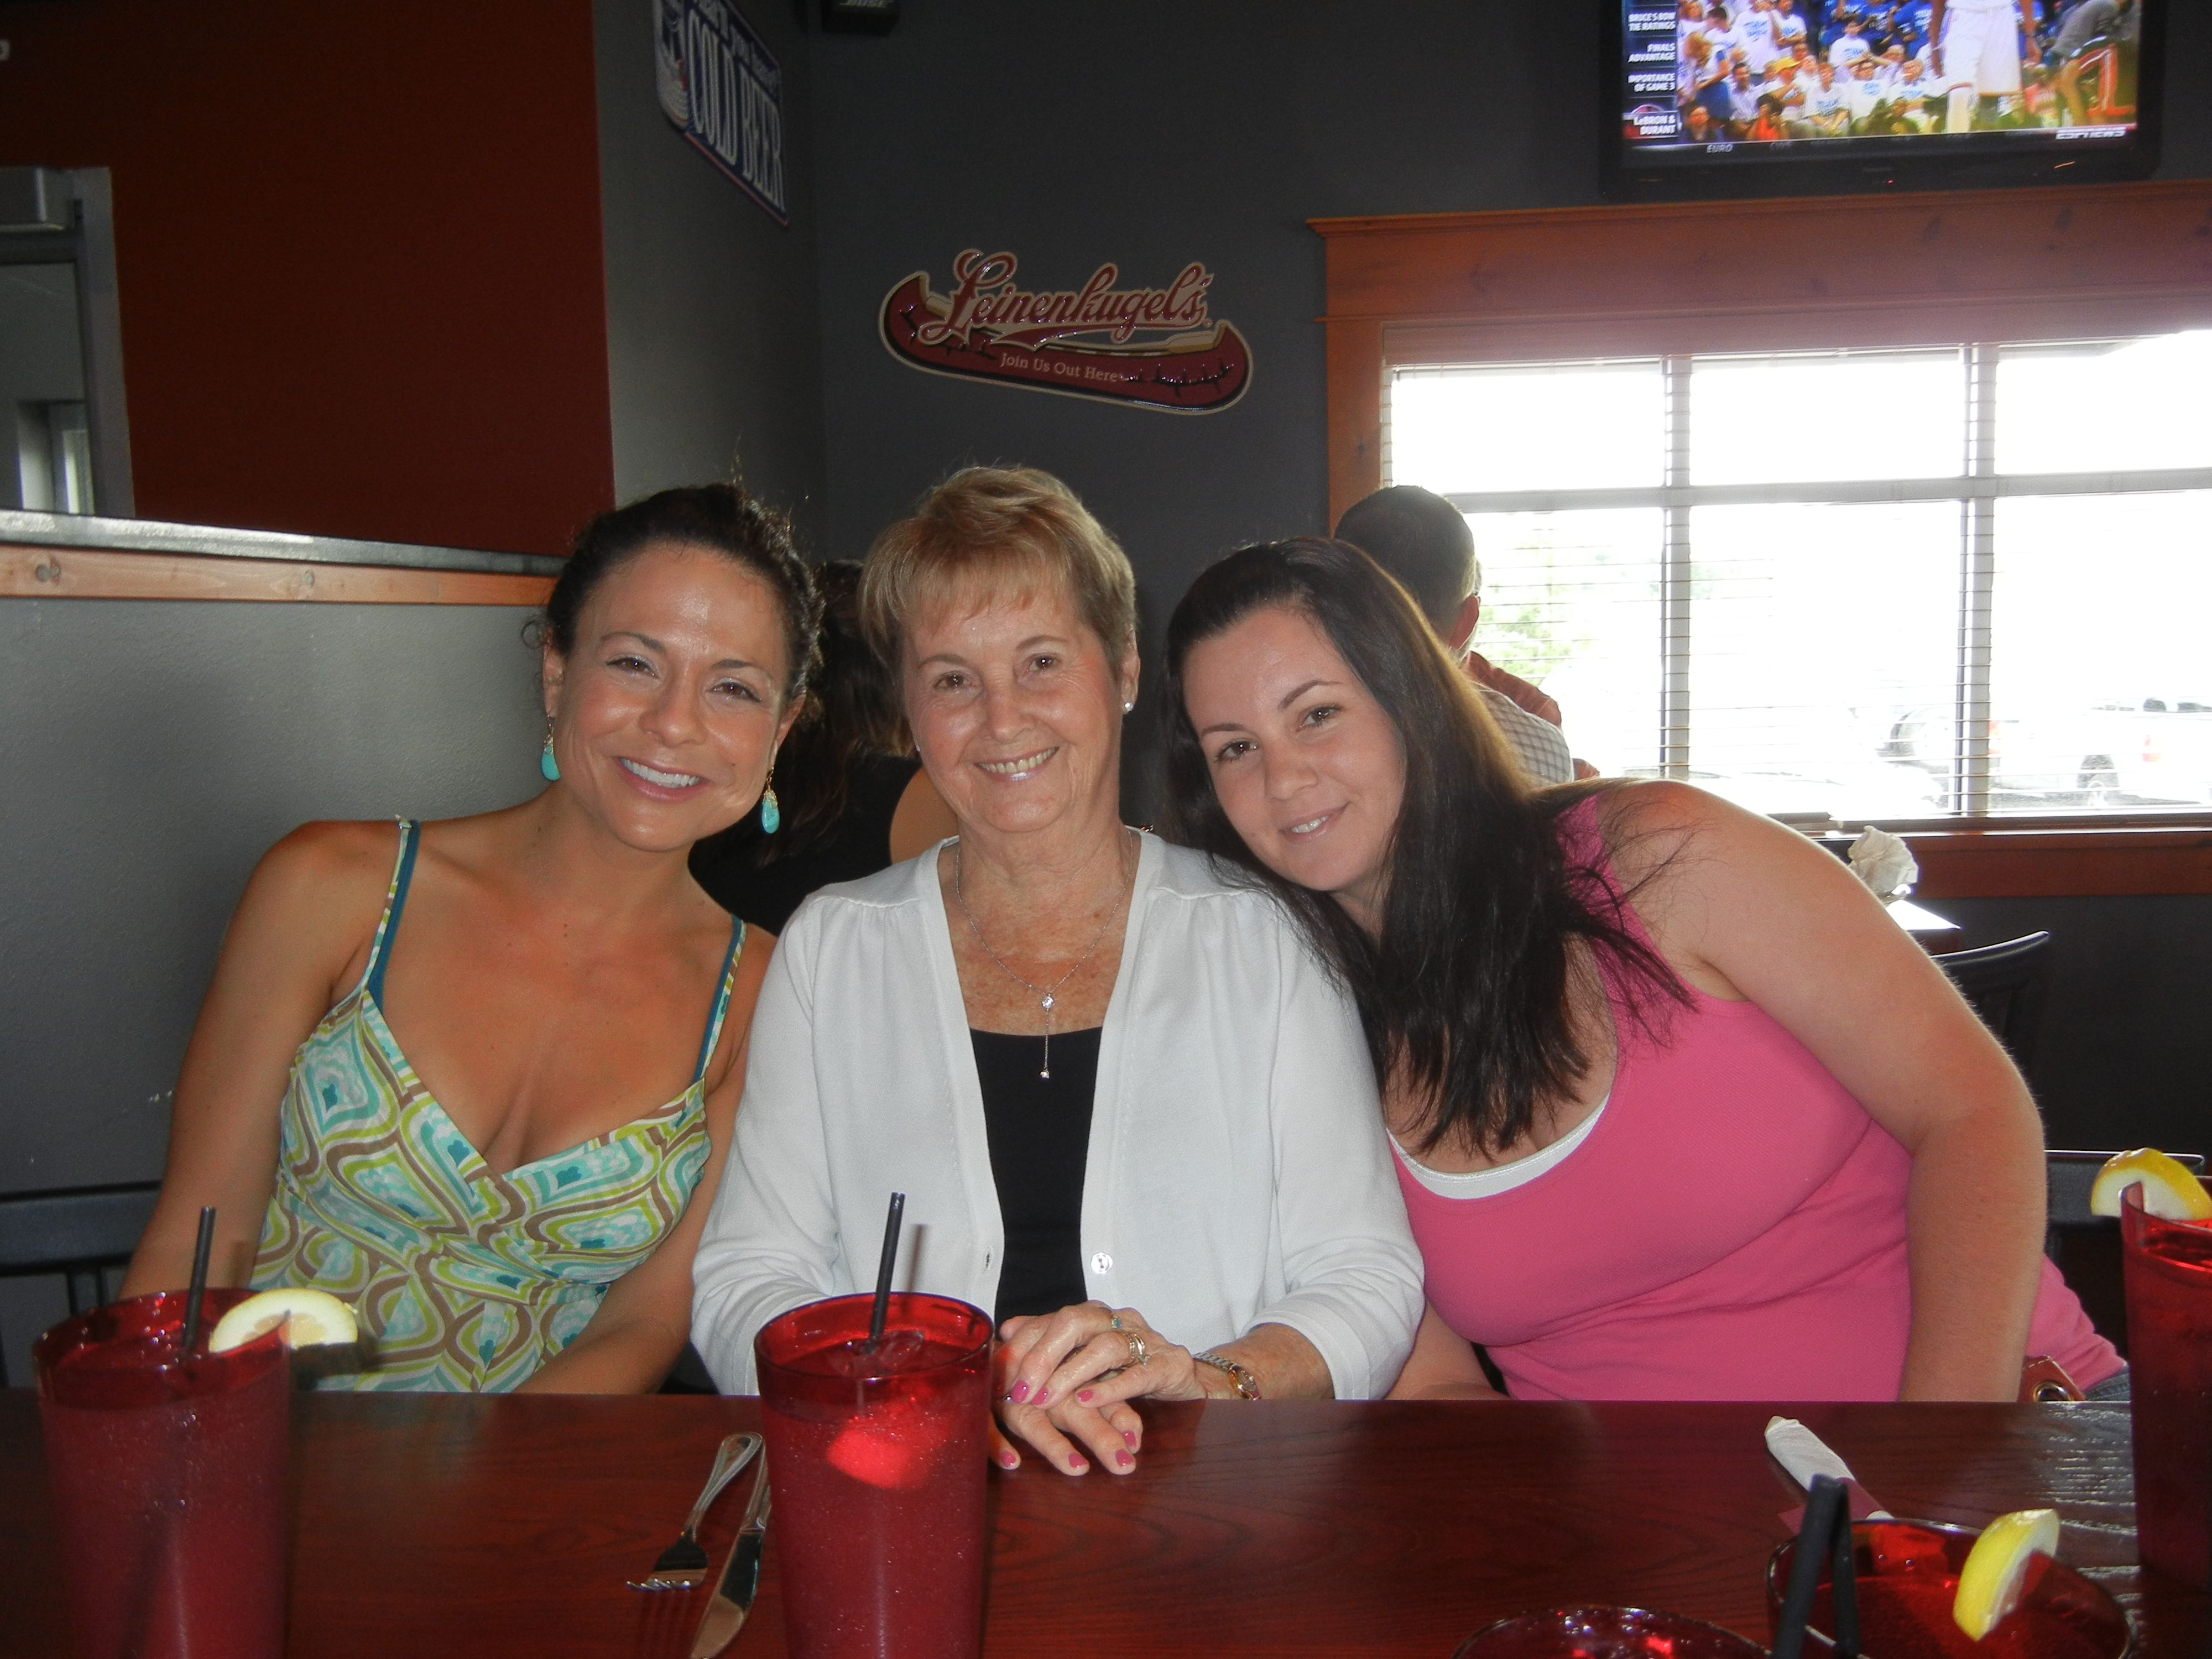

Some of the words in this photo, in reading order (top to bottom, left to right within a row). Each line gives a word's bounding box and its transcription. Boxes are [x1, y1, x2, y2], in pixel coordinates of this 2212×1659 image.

[1628, 13, 1658, 22] BRUCE'S
[1658, 12, 1676, 21] BOW
[1628, 23, 1641, 32] TIE
[1641, 21, 1676, 30] RATINGS
[1647, 43, 1676, 53] FINALS
[1627, 52, 1676, 62] ADVANTAGE
[1627, 73, 1675, 84] IMPORTANCE
[1634, 83, 1646, 92] OF
[1646, 82, 1668, 92] GAME
[1668, 82, 1676, 91] 3
[687, 8, 738, 166] COLD
[739, 62, 786, 212] BEER
[1668, 114, 1676, 124] &
[1640, 124, 1676, 135] DURANT
[1707, 144, 1733, 153] EURO
[919, 249, 1214, 342] Leinenkugel's
[1000, 352, 1029, 368] Join
[1033, 358, 1050, 372] Us
[1053, 362, 1081, 377] Out
[1084, 366, 1118, 382] Here
